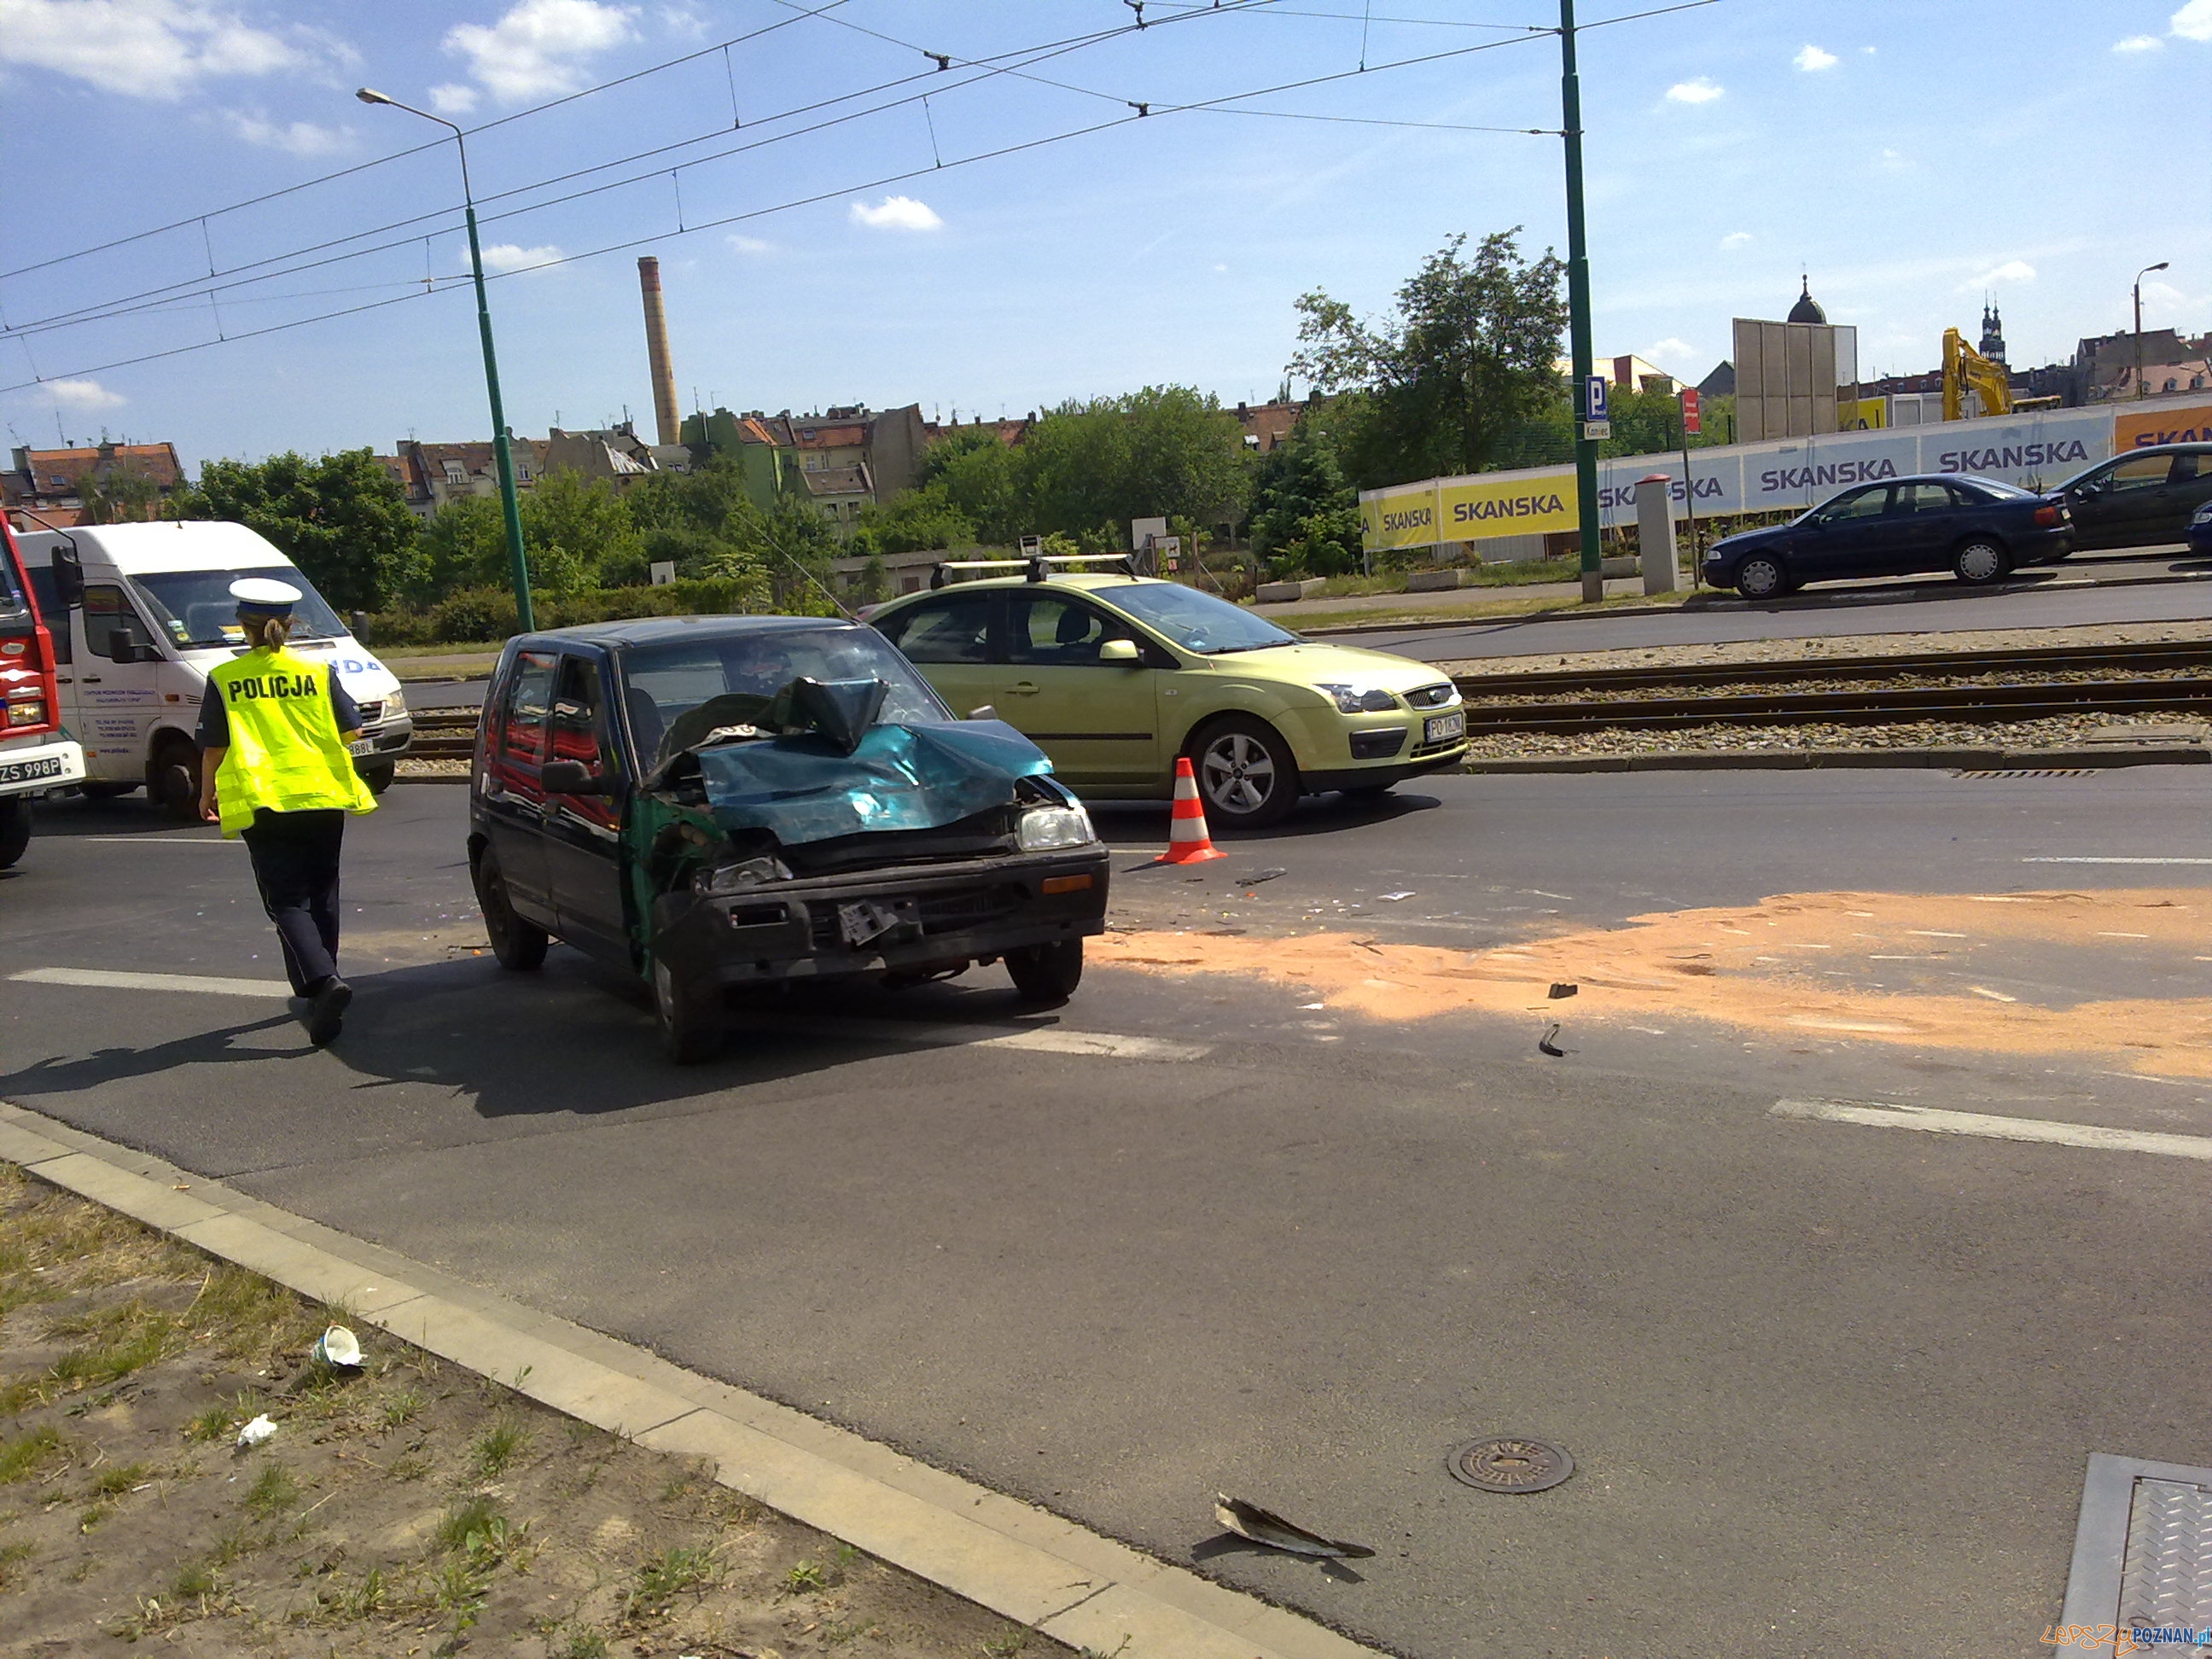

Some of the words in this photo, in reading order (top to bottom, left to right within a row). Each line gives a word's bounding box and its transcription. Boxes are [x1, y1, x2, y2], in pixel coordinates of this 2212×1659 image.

[1940, 439, 2088, 473] SKANSKA
[1761, 458, 1897, 492] SKANSKA
[1598, 477, 1724, 509] SKSKA
[1383, 507, 1432, 532] SKANSKA
[1453, 494, 1564, 522] SKANSKA
[227, 674, 318, 702] POLICJA
[24, 759, 59, 778] 998P
